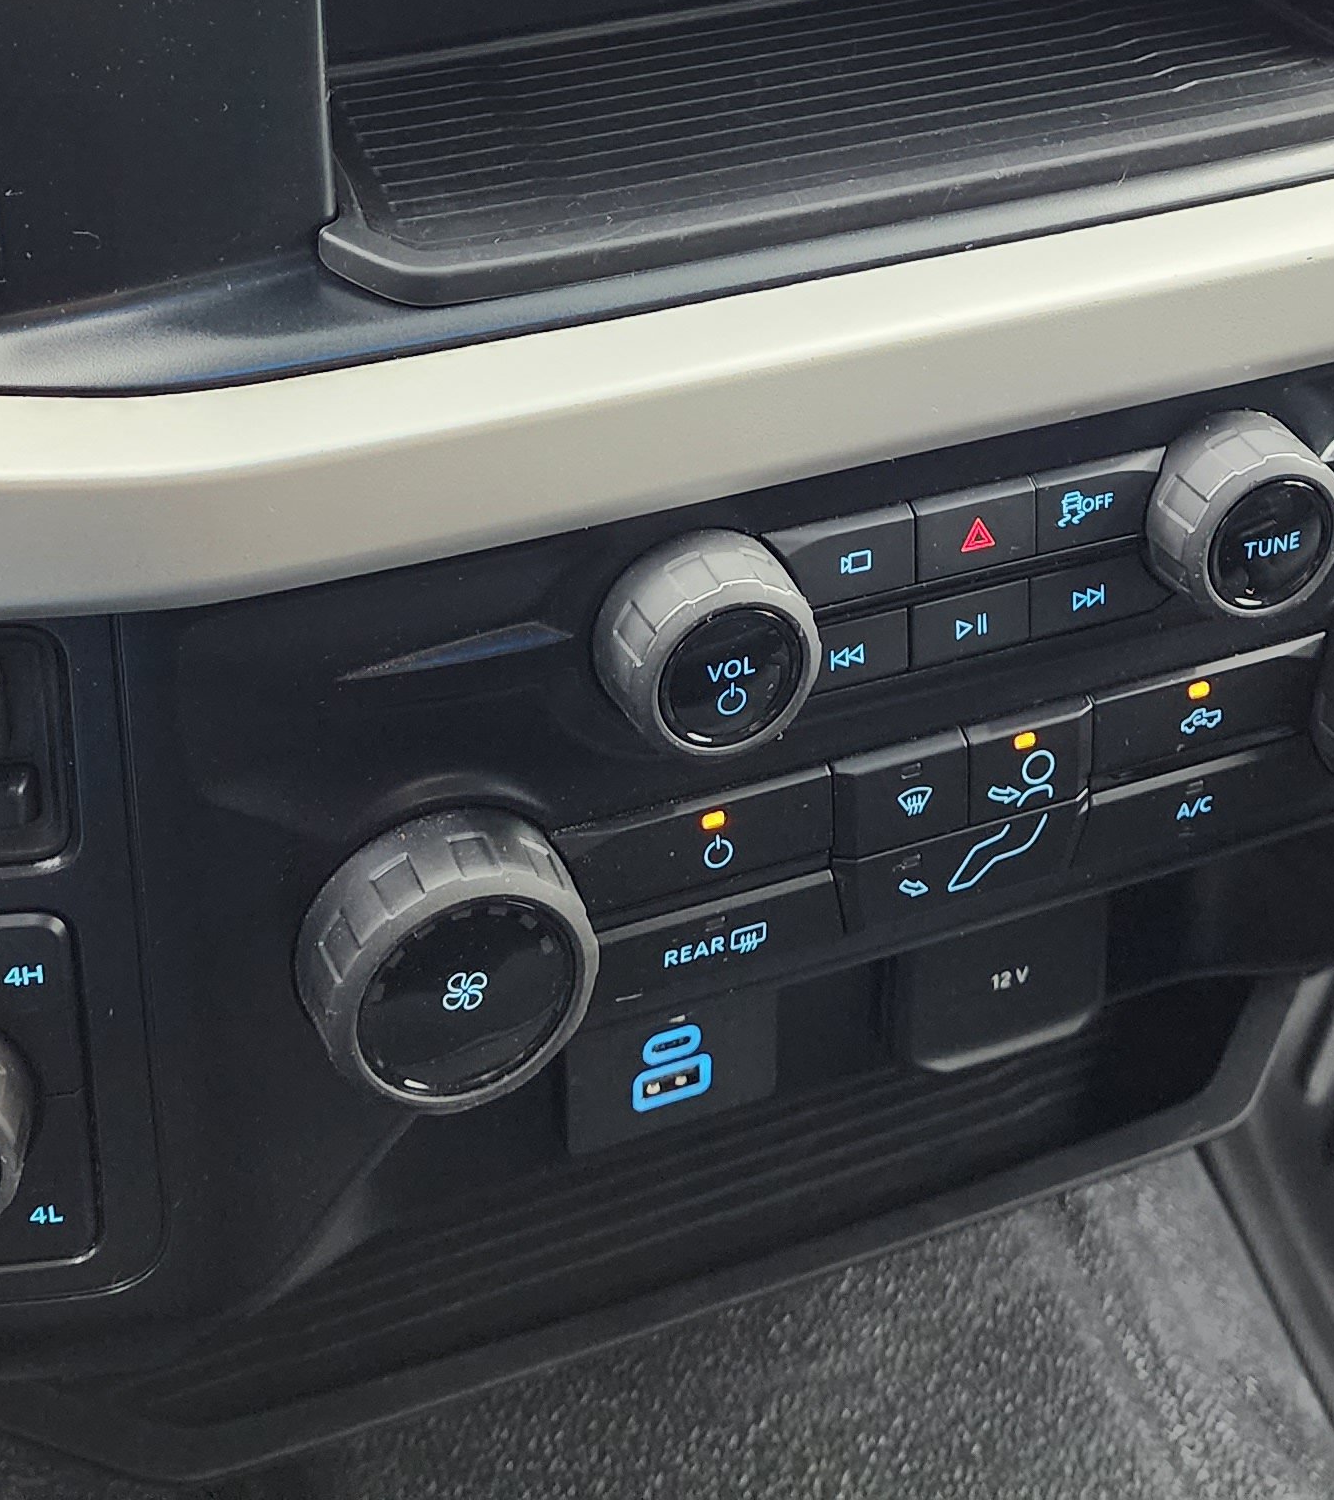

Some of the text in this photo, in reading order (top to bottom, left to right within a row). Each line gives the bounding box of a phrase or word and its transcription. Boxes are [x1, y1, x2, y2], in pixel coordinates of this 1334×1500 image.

[1082, 491, 1115, 514] OFF
[1243, 530, 1302, 560] TUNE
[705, 656, 757, 684] VOL
[1175, 795, 1214, 821] A/C
[663, 935, 726, 969] REAR
[3, 963, 45, 988] 4H
[28, 1204, 64, 1225] 4L
